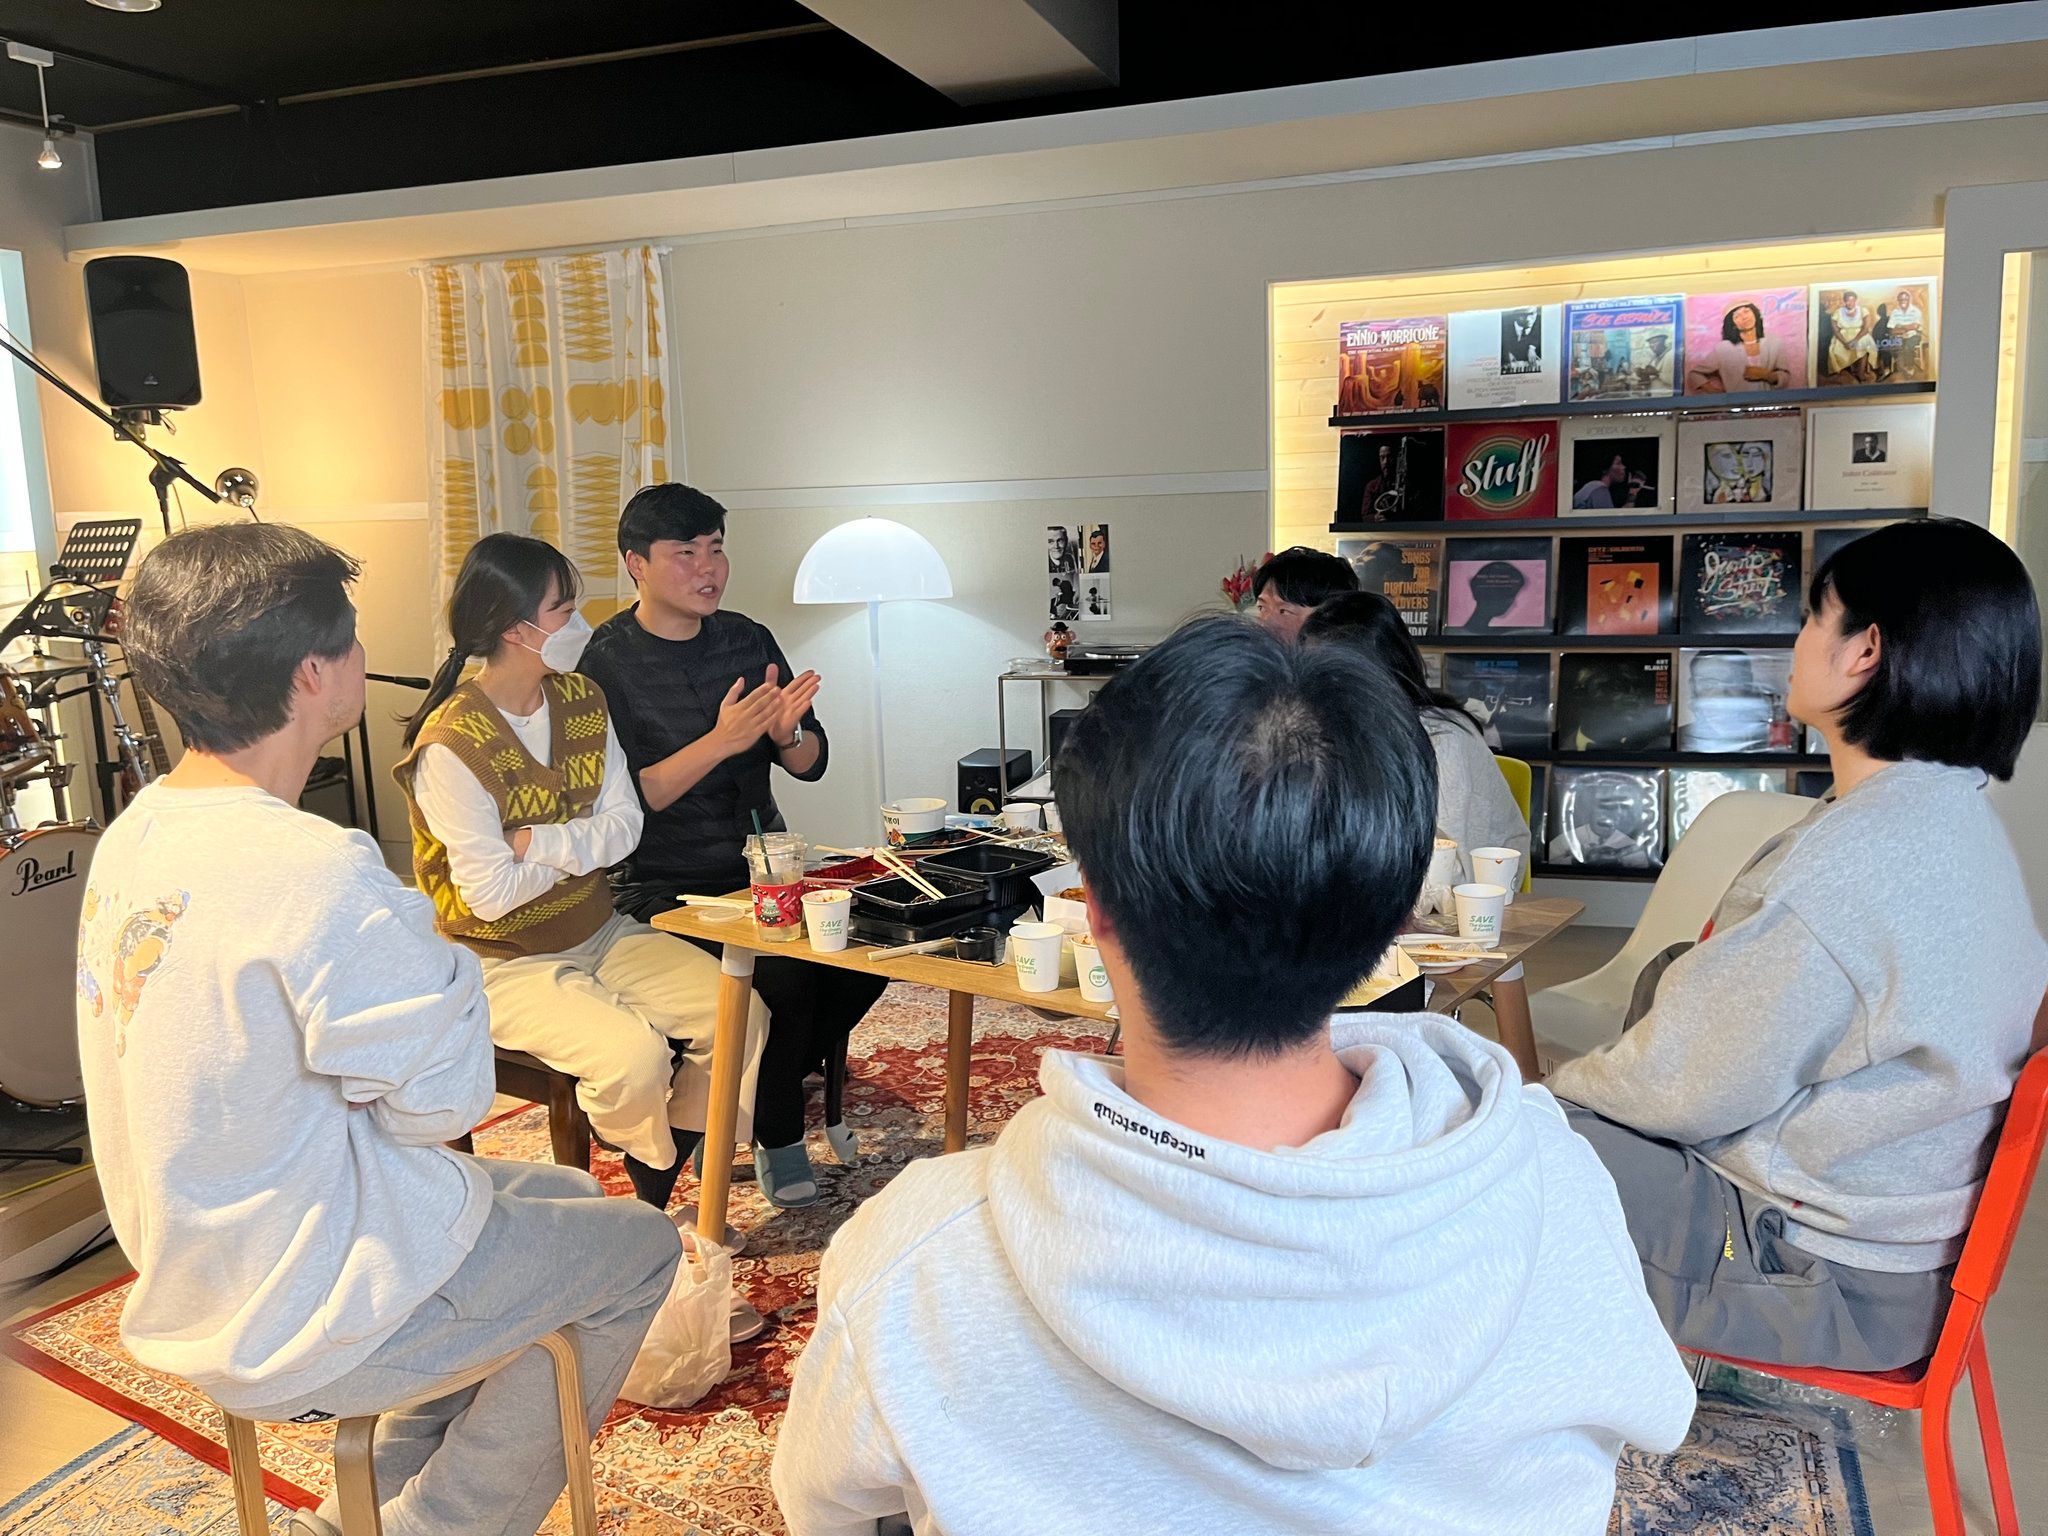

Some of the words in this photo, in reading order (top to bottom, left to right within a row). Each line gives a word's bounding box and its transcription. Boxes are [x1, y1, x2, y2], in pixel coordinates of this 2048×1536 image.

[1346, 329, 1377, 347] ENNIO
[1380, 325, 1440, 346] MORRICONE
[1458, 433, 1550, 498] Stuff
[1401, 551, 1431, 564] SONGS
[1413, 566, 1430, 580] FOR
[1401, 611, 1429, 624] BILLIE
[12, 850, 75, 896] Pearl
[820, 919, 843, 928] SAVE
[1469, 915, 1495, 923] SAVE
[1094, 1102, 1205, 1159] niceghostclub
